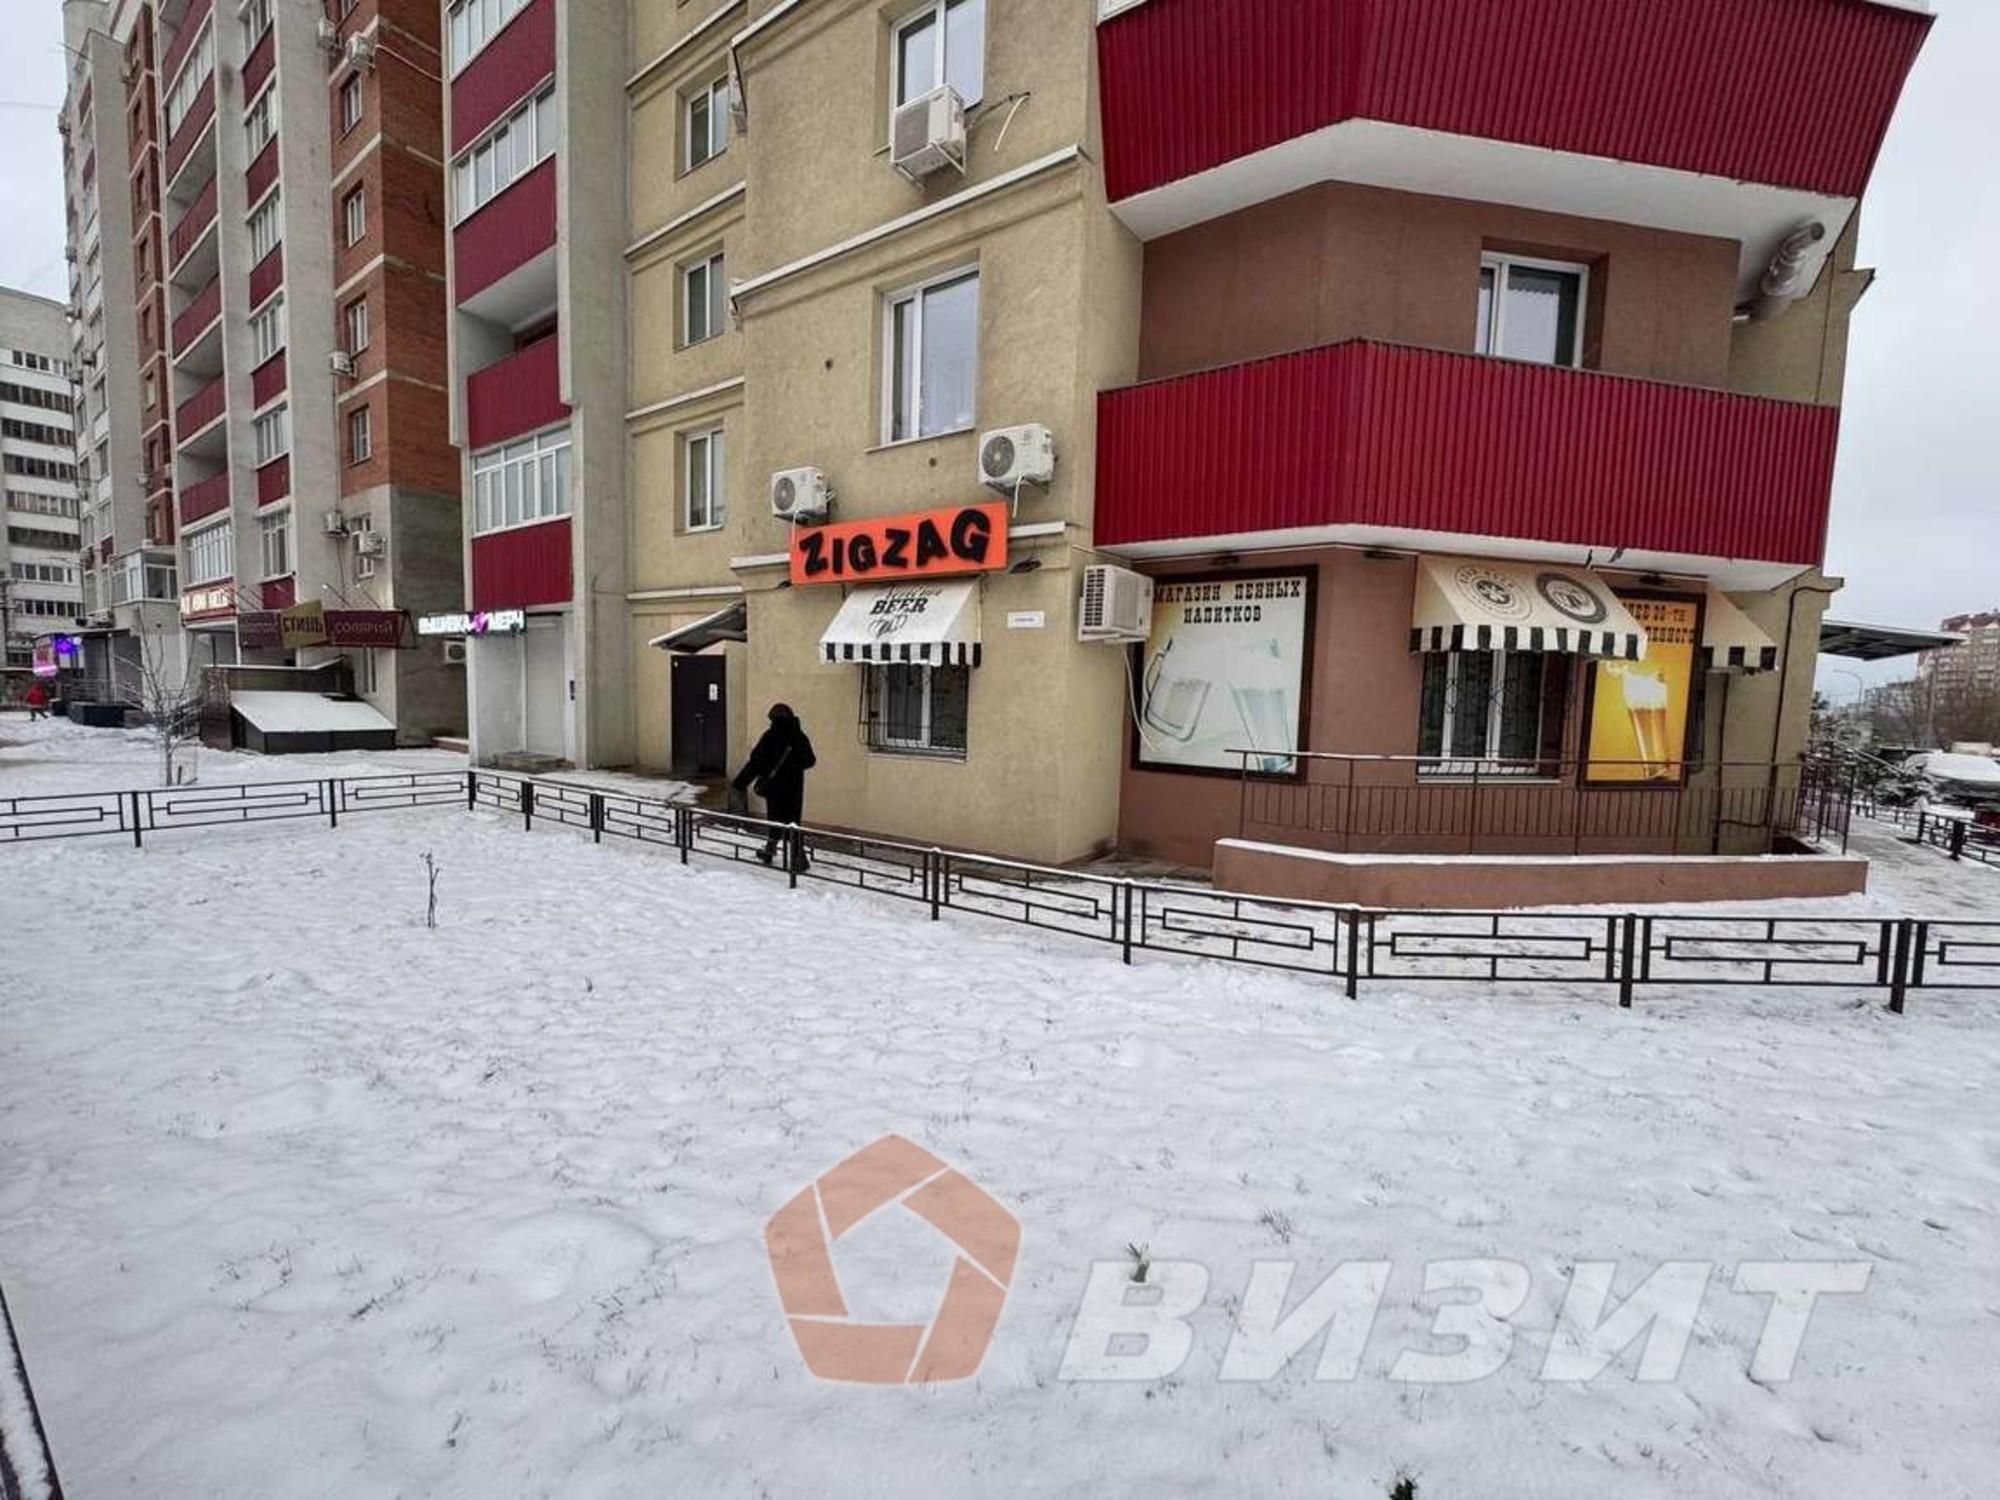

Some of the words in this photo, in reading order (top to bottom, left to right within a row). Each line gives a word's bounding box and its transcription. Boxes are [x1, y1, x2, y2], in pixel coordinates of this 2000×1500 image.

[799, 508, 992, 577] ZIGZAG
[1153, 584, 1221, 603] МАГАЗИН
[1234, 580, 1301, 600] ПЕННЫХ
[870, 597, 929, 615] BEER
[1183, 605, 1262, 624] НАПИТКОВ
[282, 616, 324, 633] СТИЛЬ
